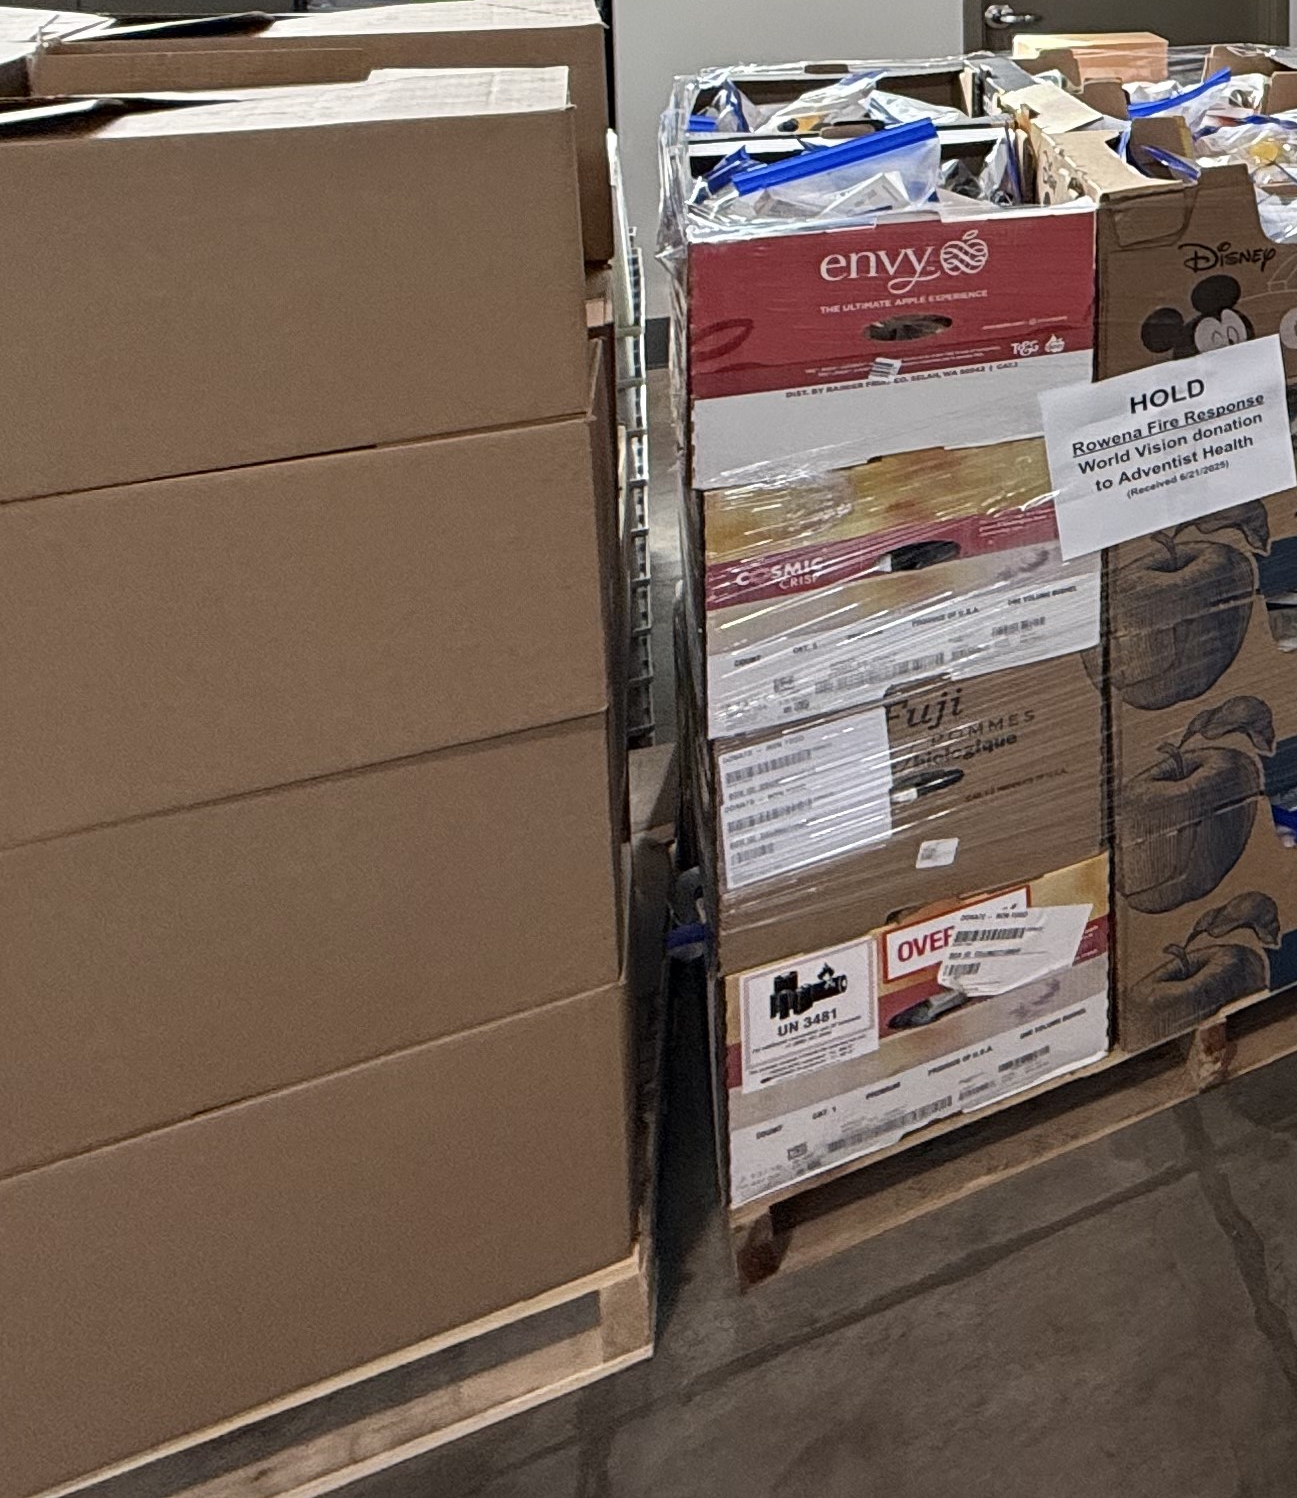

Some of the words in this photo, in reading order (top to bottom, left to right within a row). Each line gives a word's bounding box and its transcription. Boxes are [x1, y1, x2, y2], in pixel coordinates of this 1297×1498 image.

[820, 246, 941, 294] envy
[820, 305, 840, 314] THE
[843, 299, 892, 313] ULTIMATE
[895, 295, 926, 307] APPLE
[929, 289, 988, 303] EXPERIENCE
[1130, 379, 1205, 414] HOLD
[1072, 428, 1143, 456] Rowena
[1147, 417, 1180, 436] Fire
[1184, 394, 1264, 423] Response
[1078, 450, 1131, 475] World
[1135, 435, 1188, 459] Vision
[1192, 413, 1263, 442] donation
[1095, 477, 1114, 492] to
[1118, 452, 1199, 485] Adventist
[1202, 436, 1254, 459] Health
[1127, 474, 1178, 500] (Received
[735, 557, 826, 587] COSMIC
[884, 688, 963, 730] Fuji
[931, 709, 1036, 746] POMMES
[778, 1018, 799, 1037] UN
[803, 1008, 838, 1030] 3481
